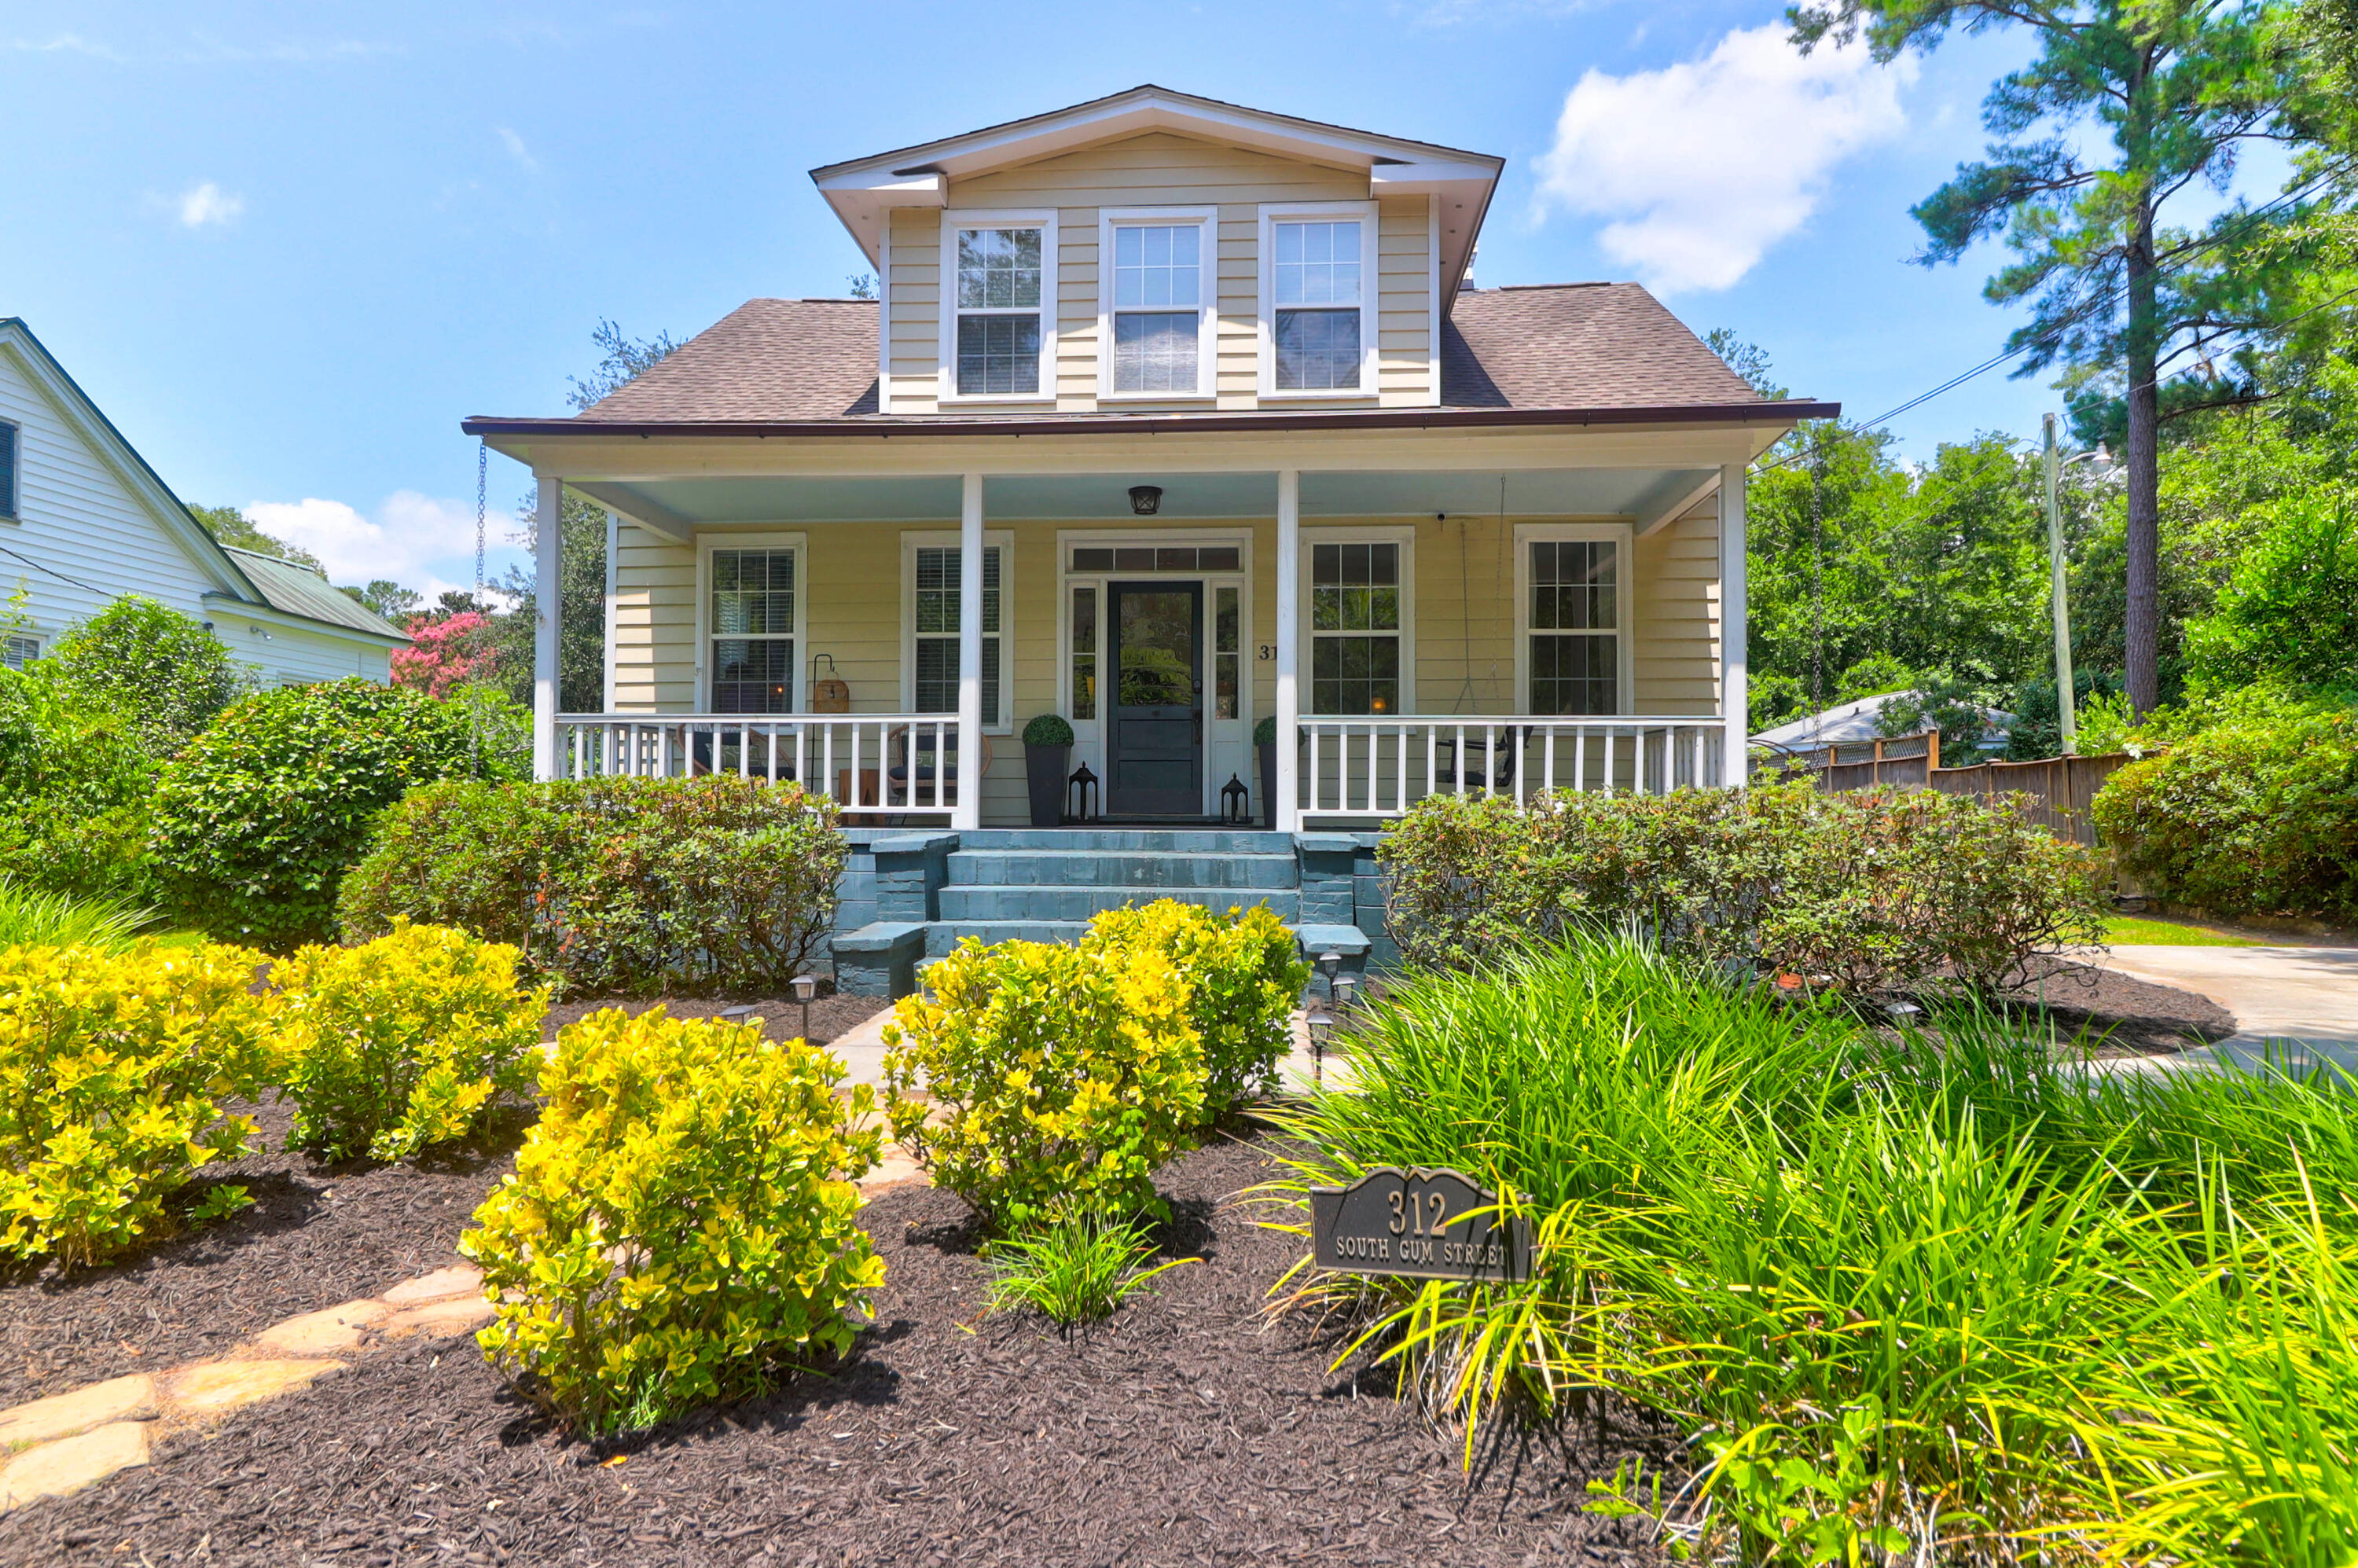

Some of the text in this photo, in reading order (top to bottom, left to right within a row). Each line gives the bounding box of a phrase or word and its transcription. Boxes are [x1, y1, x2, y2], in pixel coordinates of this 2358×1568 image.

[1388, 1190, 1445, 1236] 312
[1336, 1236, 1507, 1266] SOUTH GUM STREET
